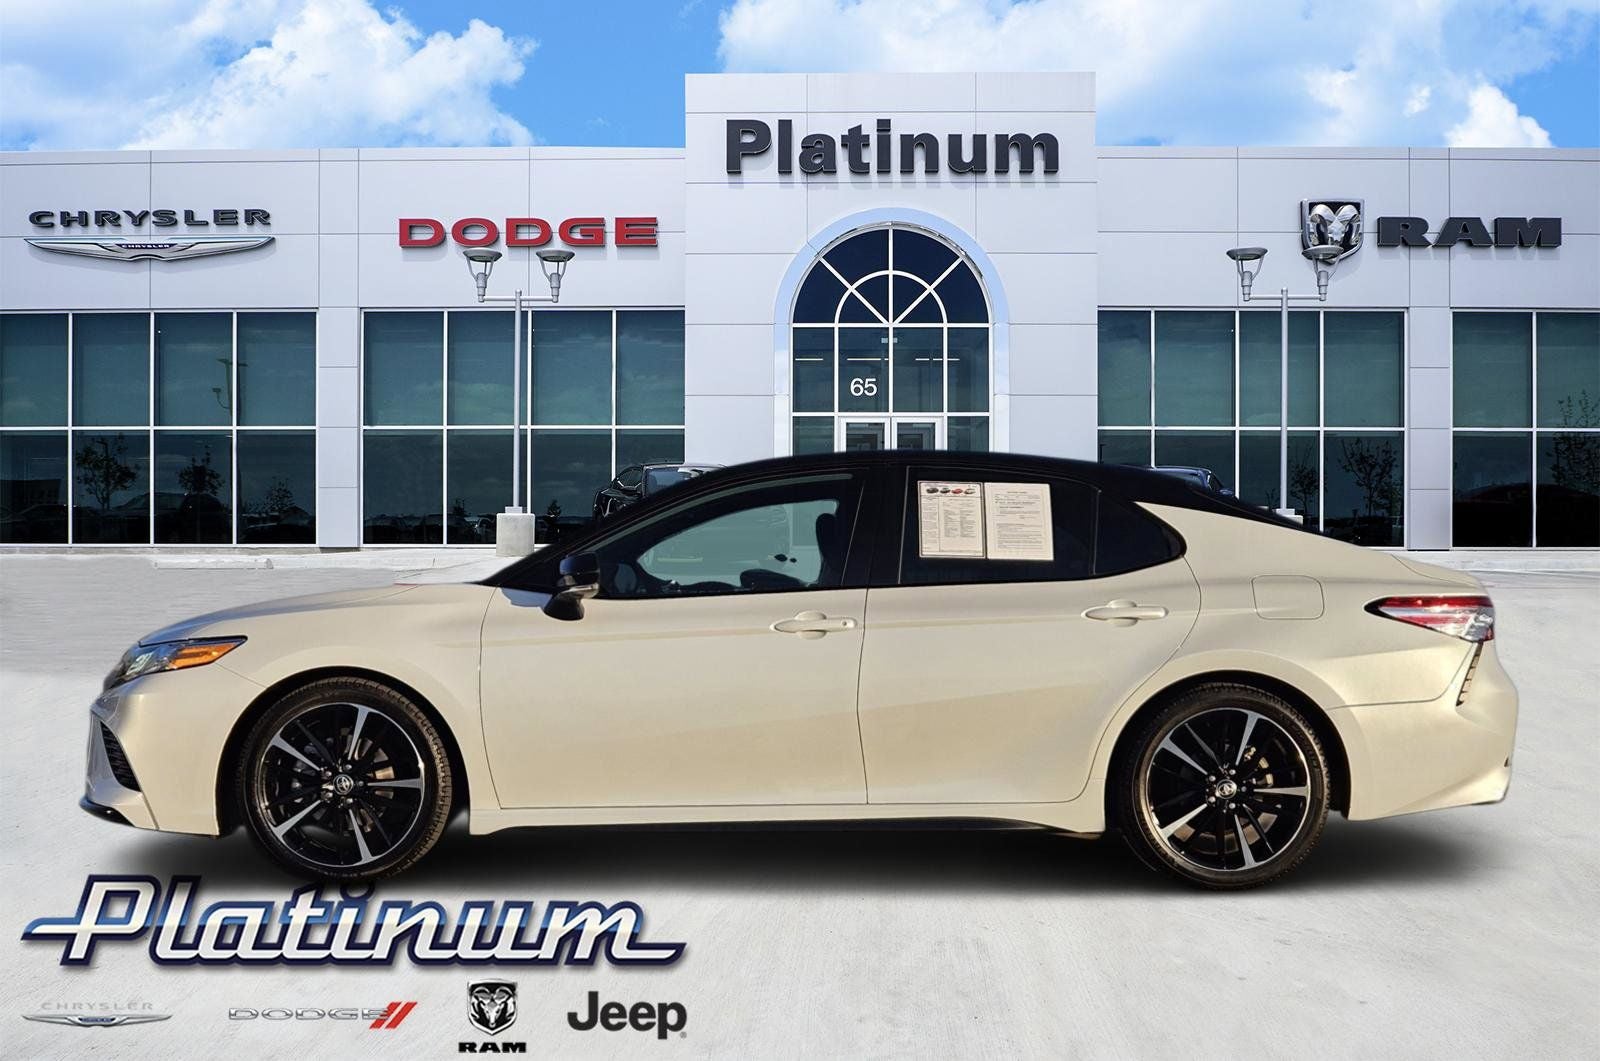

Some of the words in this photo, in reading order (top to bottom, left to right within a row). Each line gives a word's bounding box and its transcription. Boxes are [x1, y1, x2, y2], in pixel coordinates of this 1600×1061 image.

[726, 118, 1060, 175] Platinum
[28, 208, 272, 228] CHRYSLER
[398, 216, 659, 249] DODGE
[1376, 216, 1562, 249] RAM
[850, 378, 878, 397] 65
